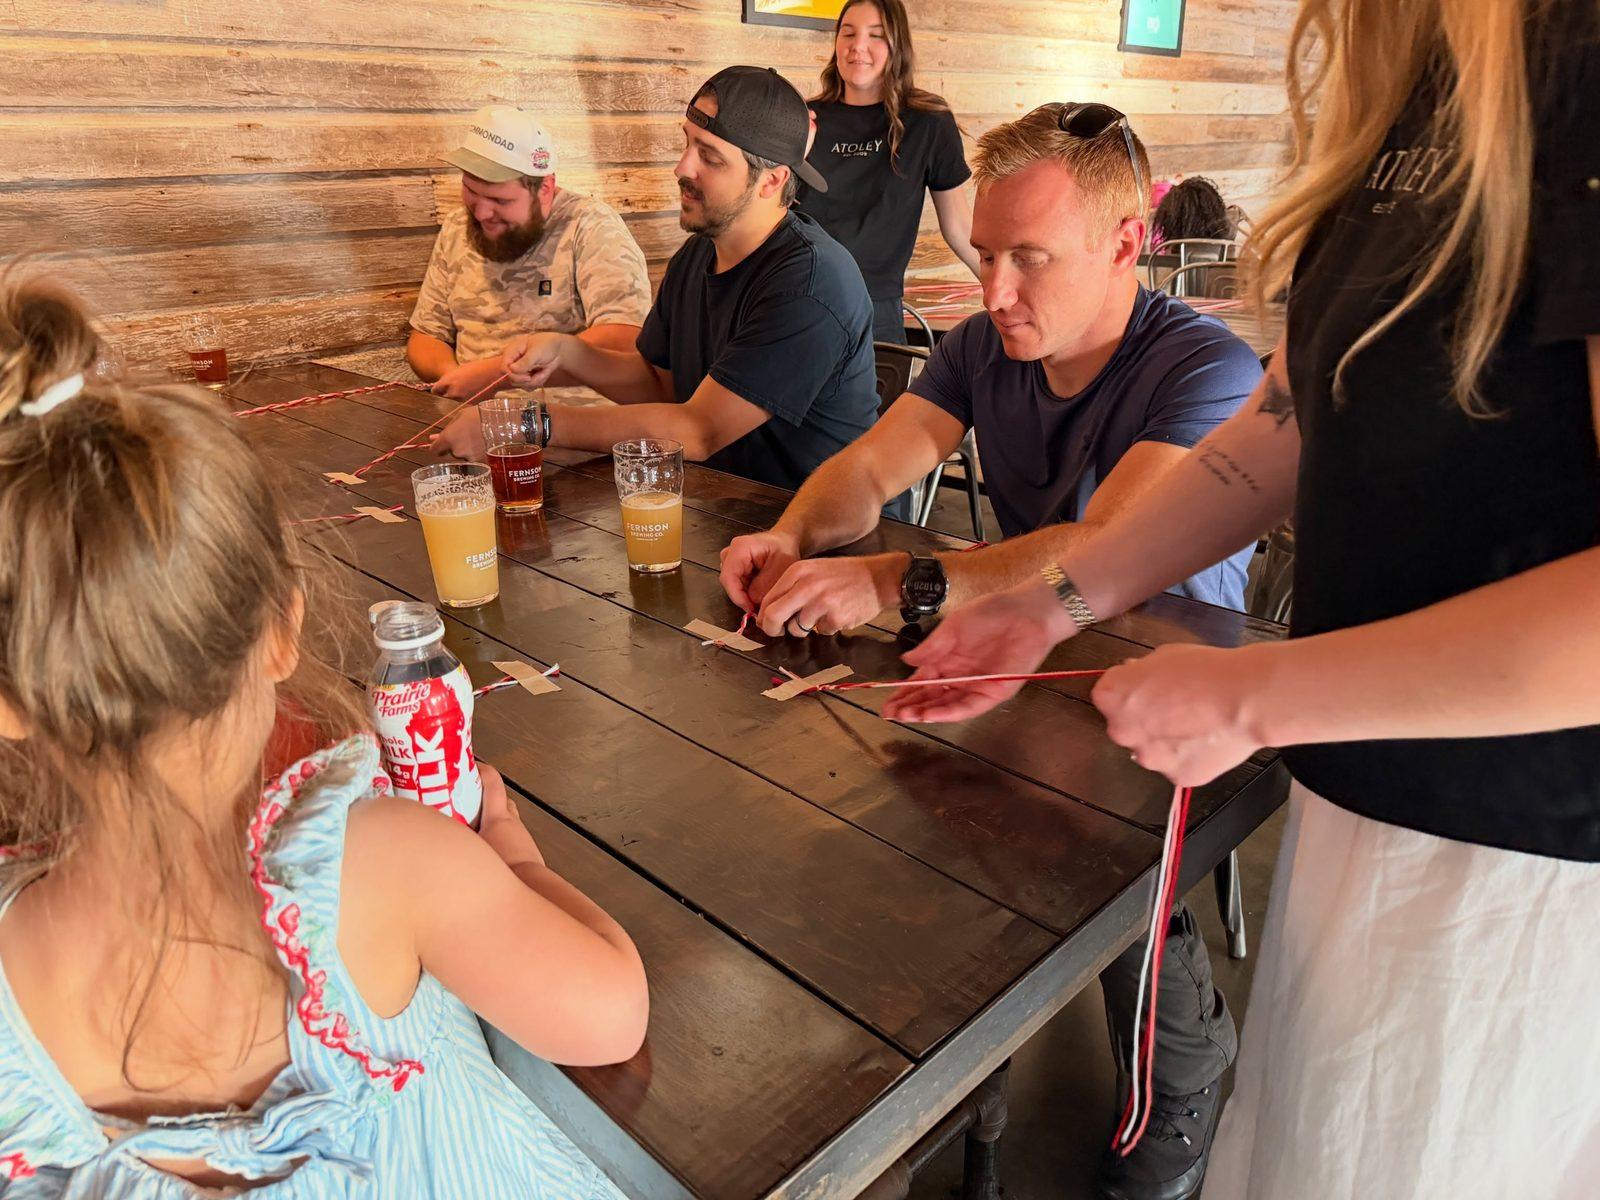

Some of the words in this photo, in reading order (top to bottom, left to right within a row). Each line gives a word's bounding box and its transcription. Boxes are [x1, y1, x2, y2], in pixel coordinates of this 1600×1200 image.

[831, 140, 882, 153] ATOLEY
[627, 523, 669, 532] FERNSON
[465, 546, 497, 564] FERNS
[372, 684, 429, 705] Prairie
[379, 702, 419, 718] Farms
